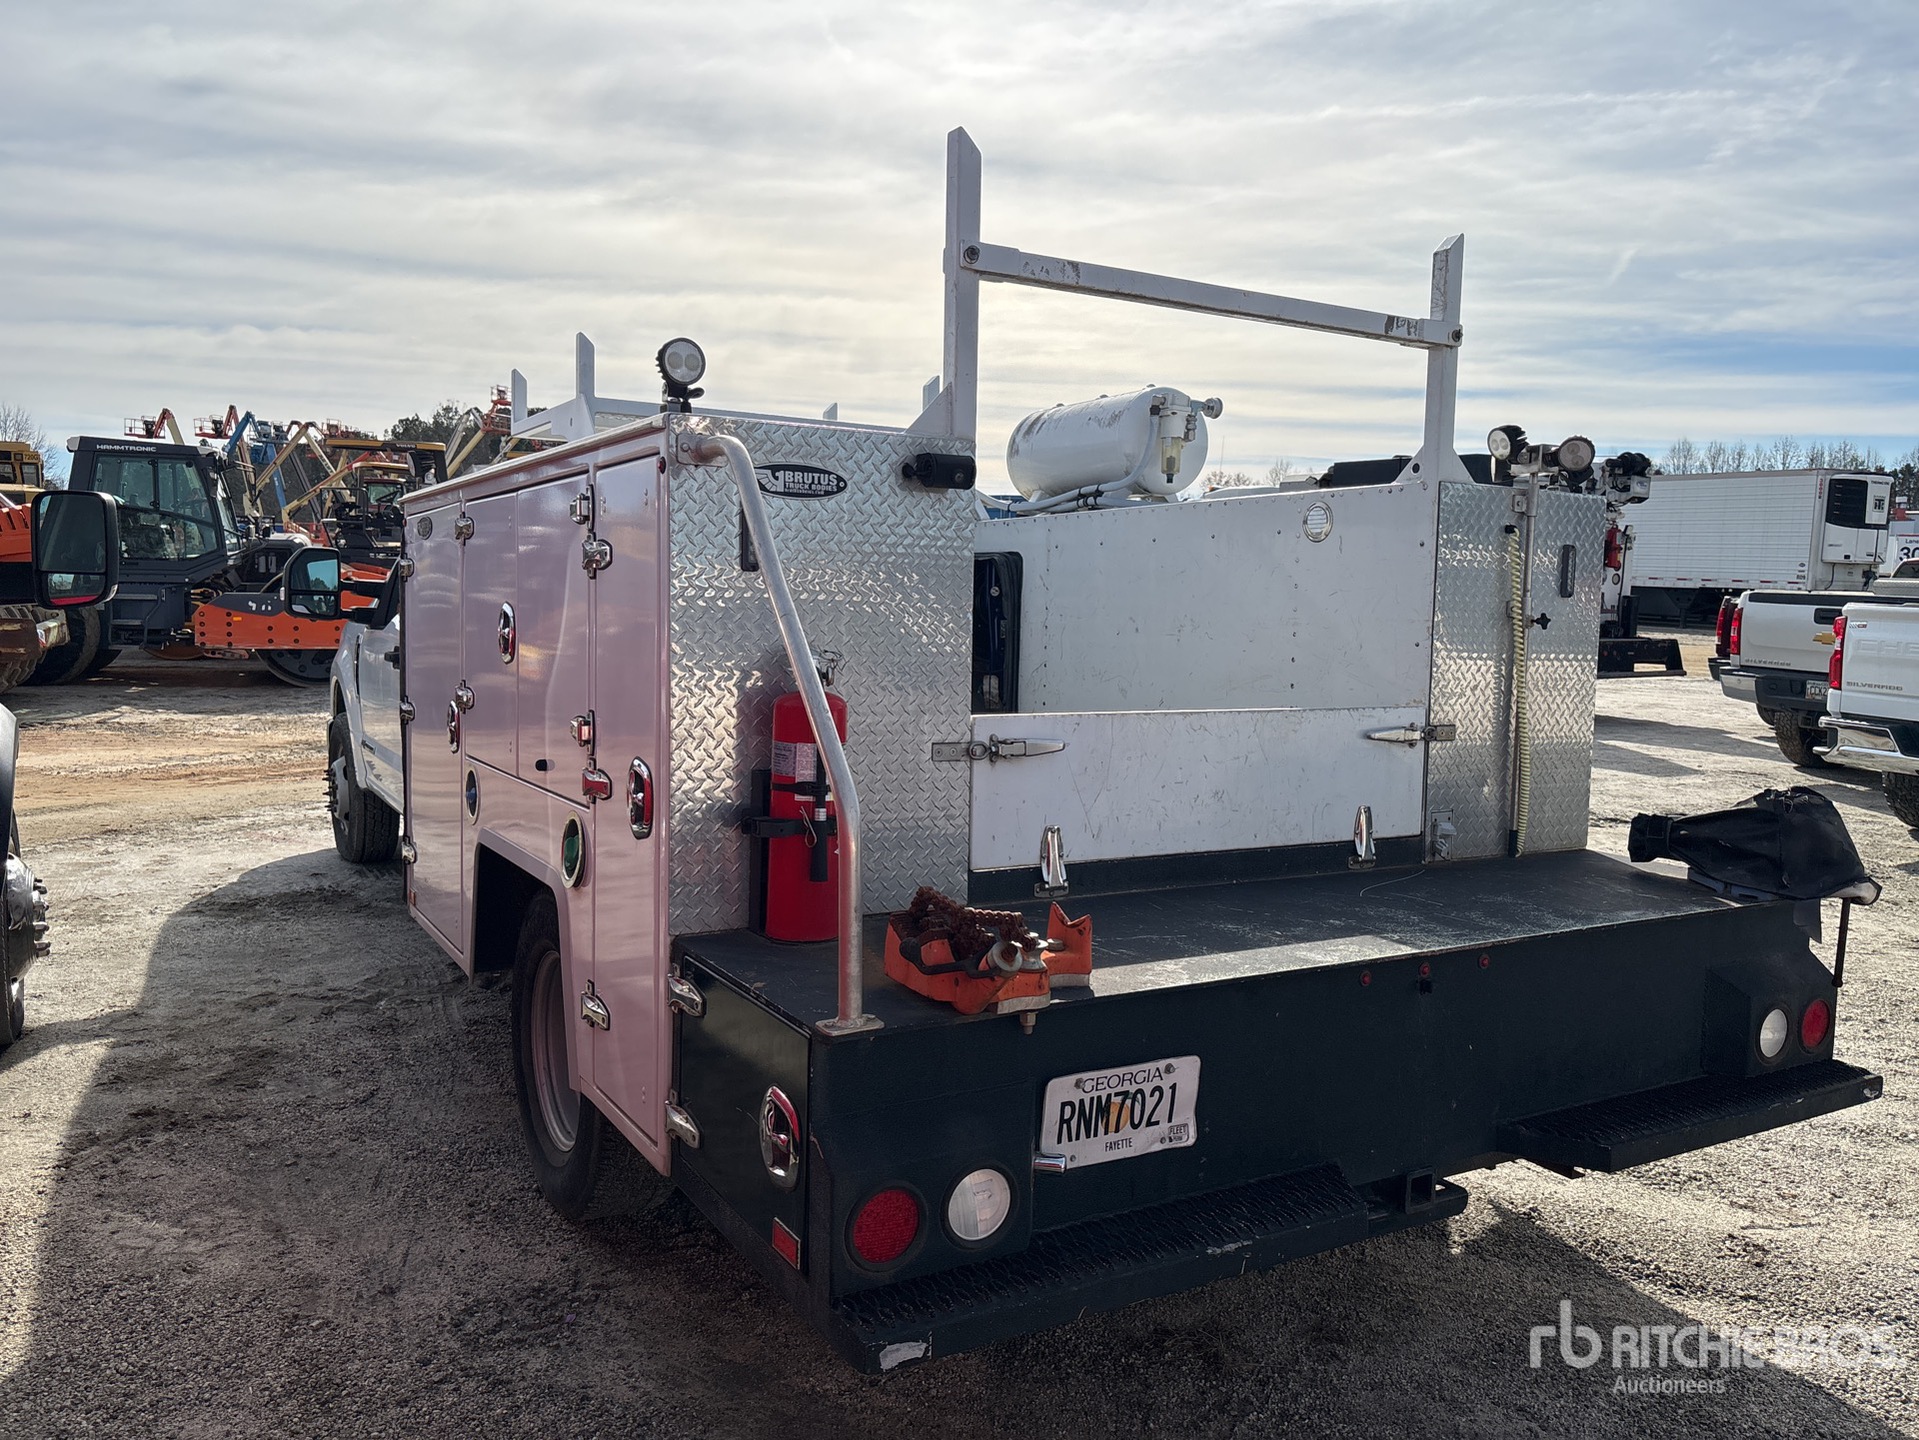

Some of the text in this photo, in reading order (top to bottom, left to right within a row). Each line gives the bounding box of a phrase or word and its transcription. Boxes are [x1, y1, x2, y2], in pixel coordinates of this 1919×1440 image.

[96, 444, 157, 452] HAMMTRONIC
[24, 453, 39, 461] 720G
[785, 470, 837, 486] BRUTUS
[785, 482, 810, 490] TRUCK
[811, 484, 838, 492] BODIES
[1846, 681, 1903, 691] SILVERADO
[1082, 1067, 1163, 1094] GEORGIA
[1057, 1082, 1177, 1145] RNM7021
[1169, 1125, 1187, 1136] FLEET
[1104, 1137, 1133, 1152] FAYETTE
